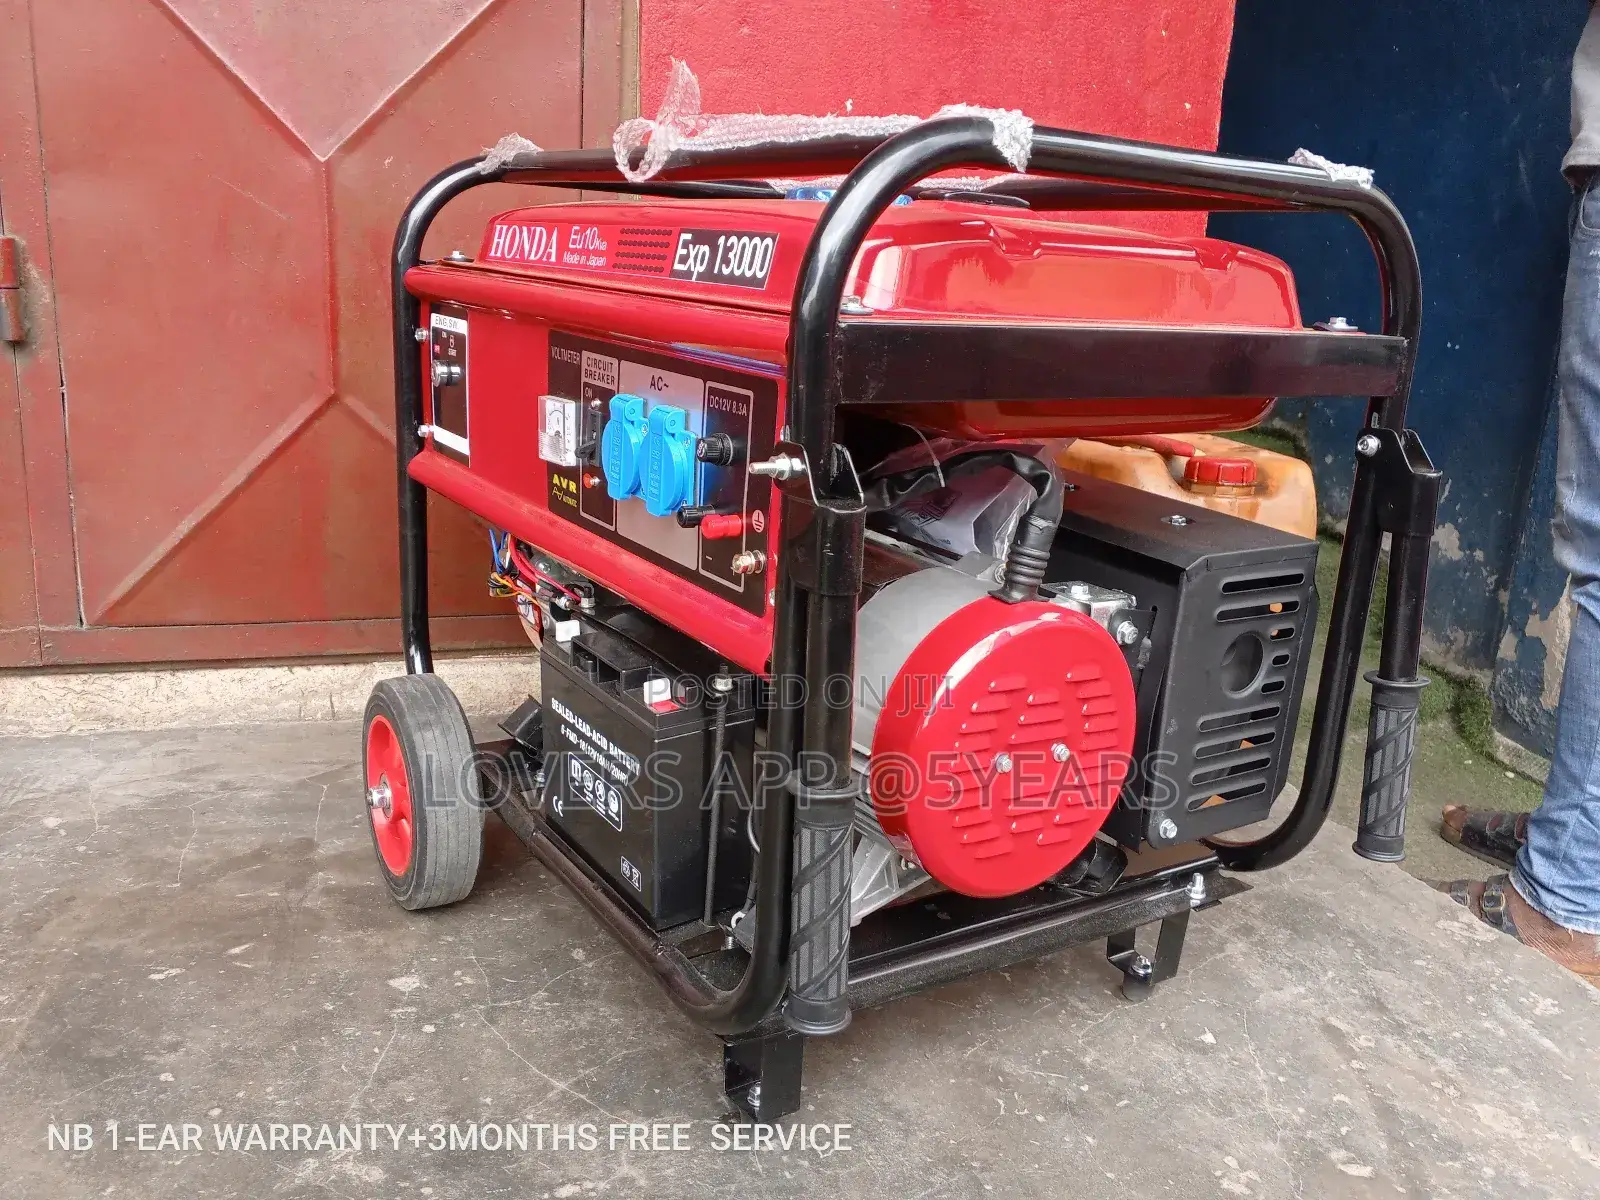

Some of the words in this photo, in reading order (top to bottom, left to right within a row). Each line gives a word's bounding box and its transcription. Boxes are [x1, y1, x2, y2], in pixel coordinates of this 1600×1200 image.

[489, 224, 558, 262] HONDA
[562, 250, 580, 264] Made
[580, 254, 587, 265] in
[586, 254, 607, 268] Japan
[672, 233, 710, 281] Exp
[713, 235, 774, 279] 13000
[551, 345, 581, 365] VOLTMETER
[586, 356, 614, 373] CIRCUIT
[584, 367, 615, 386] BREAKER
[584, 387, 593, 398] ON
[709, 395, 731, 413] DC12V
[732, 400, 748, 417] 8.3A
[553, 473, 577, 494] AVR
[609, 741, 640, 776] BATTERY
